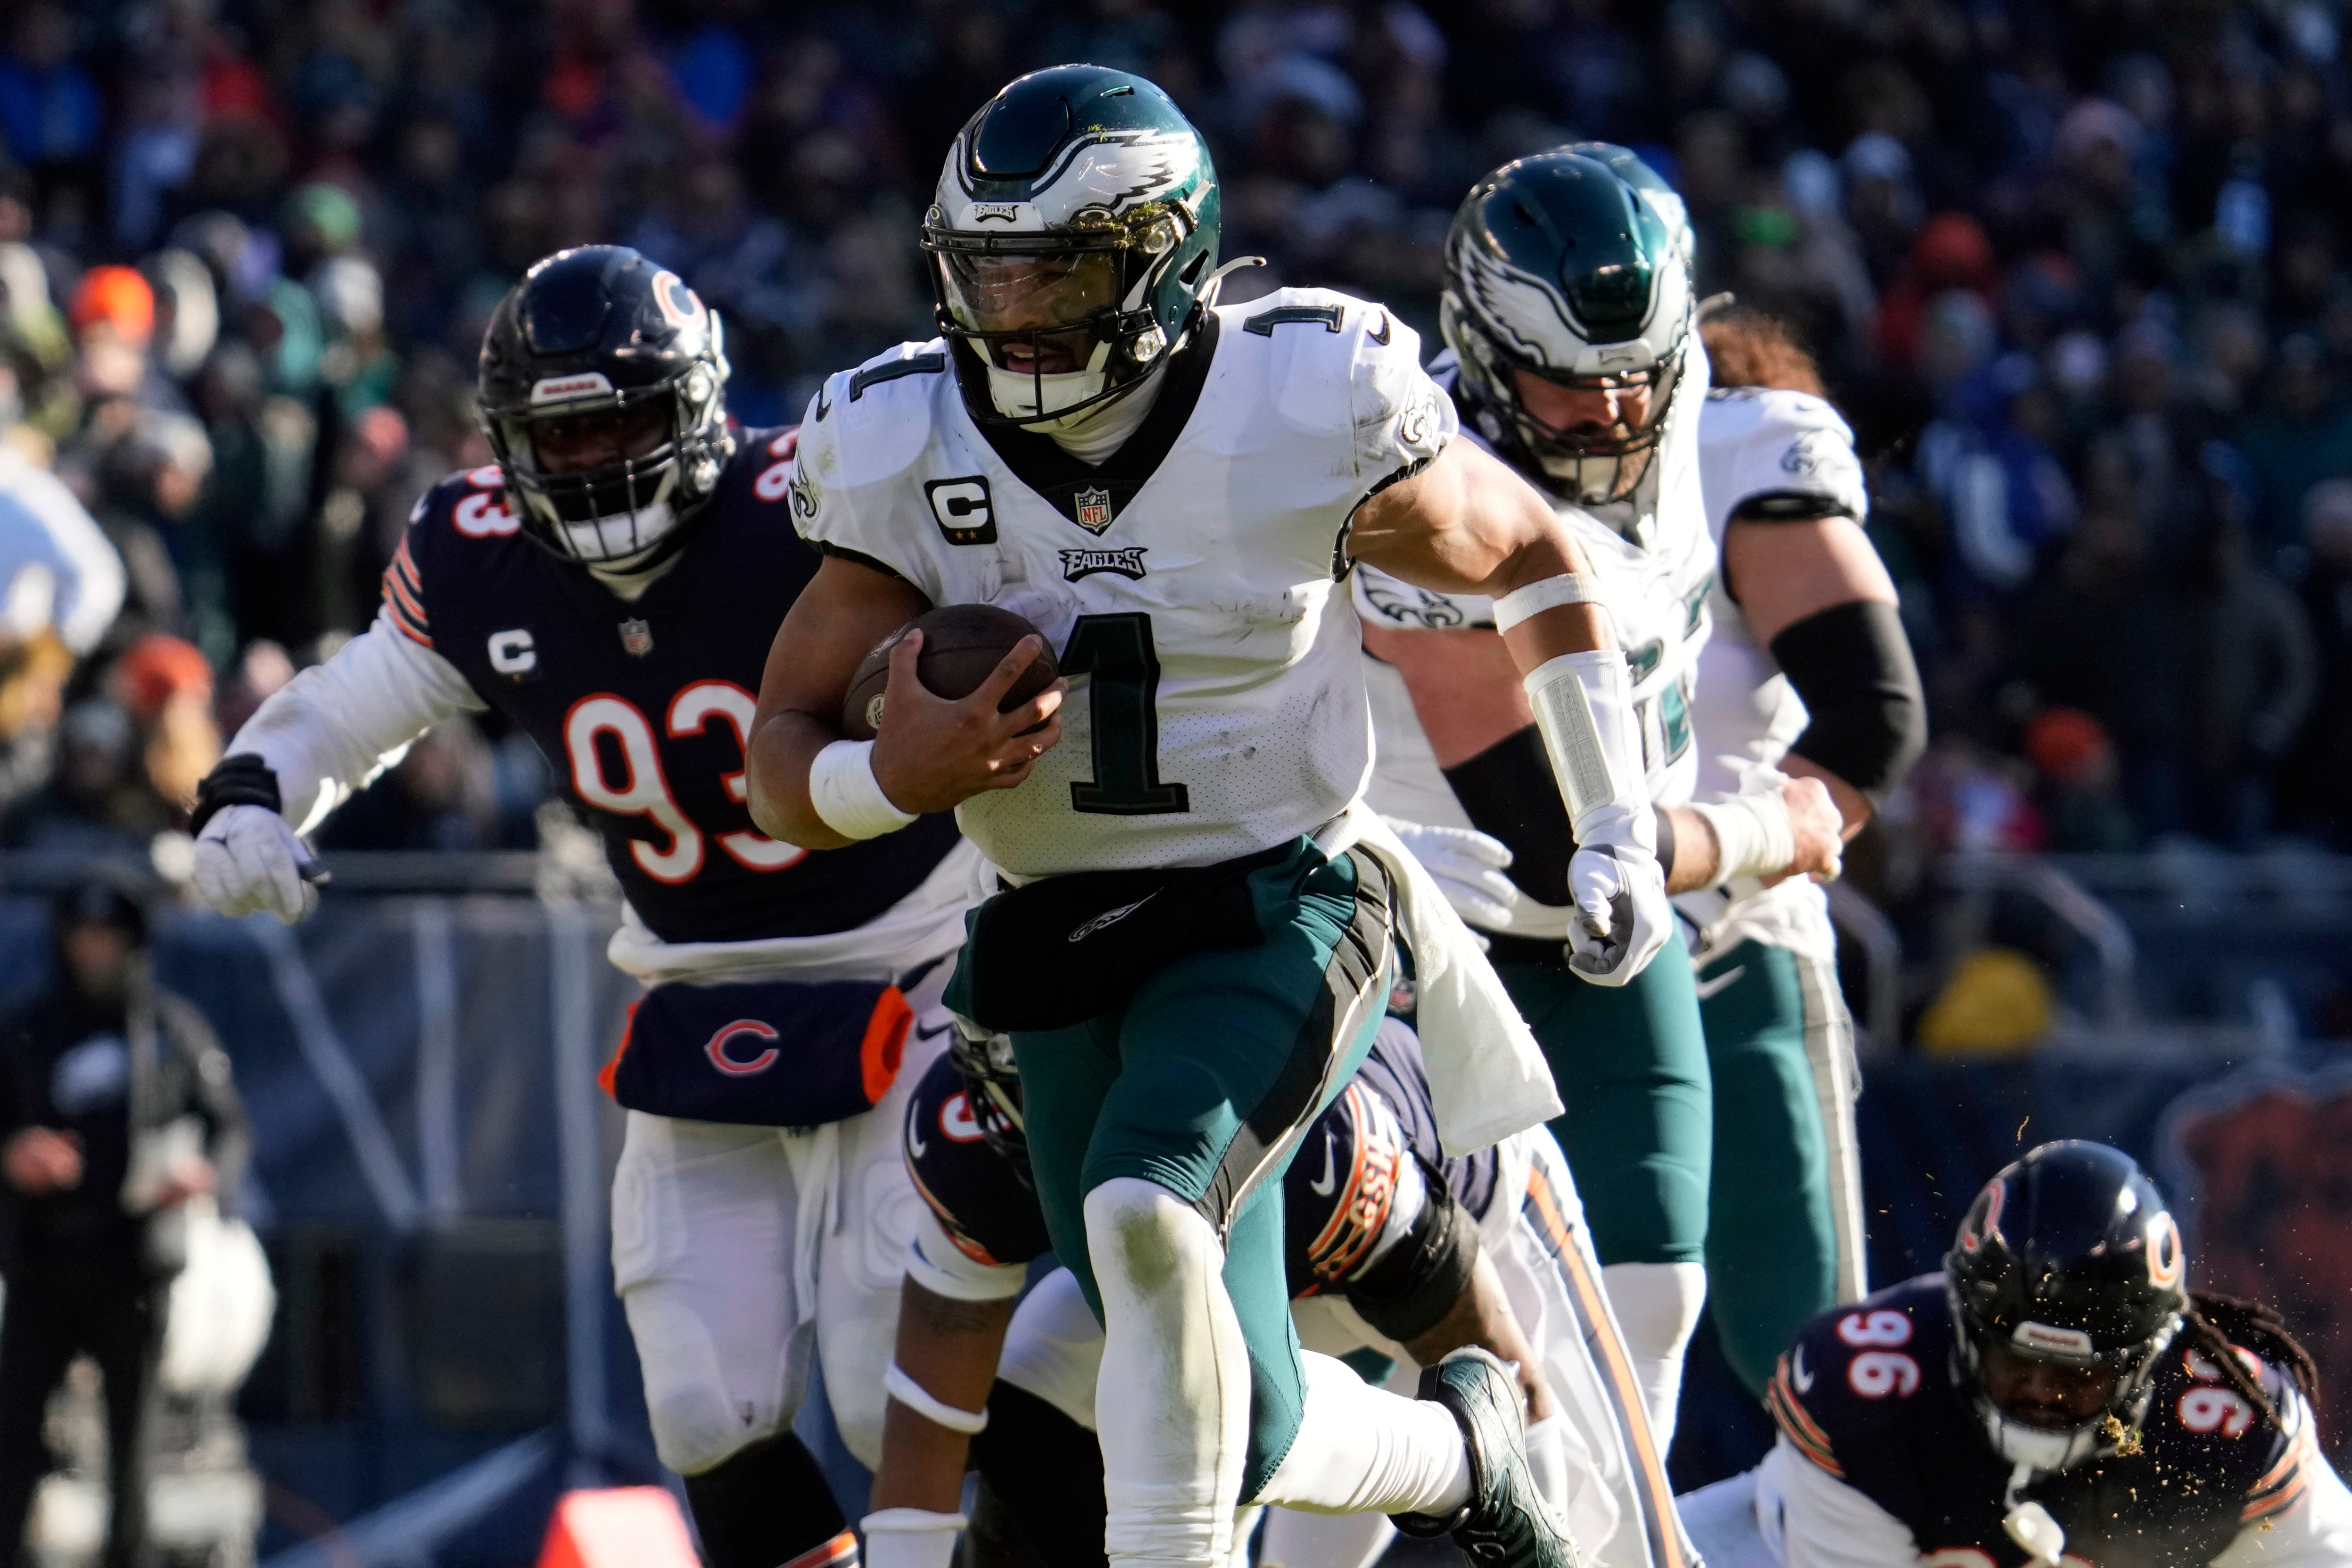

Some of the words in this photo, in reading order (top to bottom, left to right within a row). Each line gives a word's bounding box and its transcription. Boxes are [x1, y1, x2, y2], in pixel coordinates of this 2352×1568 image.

[975, 204, 1017, 221] EAGLES
[1243, 304, 1345, 338] 1
[931, 481, 990, 529] C
[1082, 506, 1106, 523] NFL
[1059, 547, 1147, 581] EAGLES
[487, 628, 537, 674] C
[1059, 612, 1190, 816] 1
[563, 678, 812, 886] 93
[704, 1018, 779, 1077] C
[1836, 1308, 1923, 1399] 96
